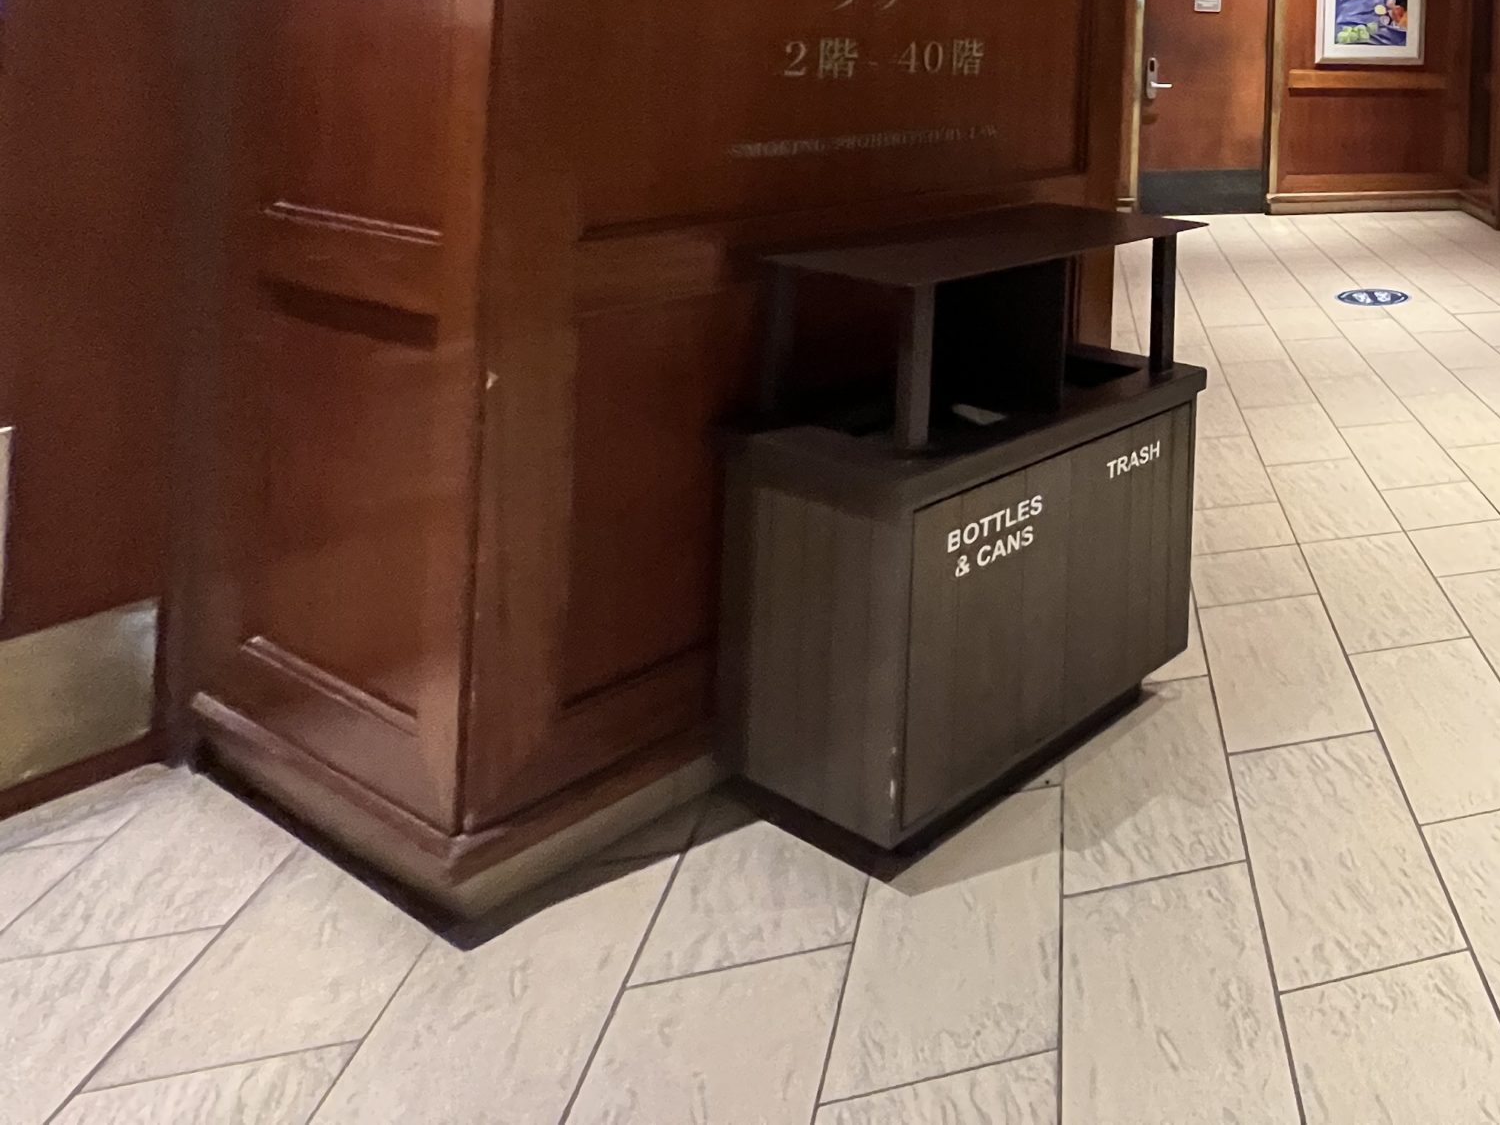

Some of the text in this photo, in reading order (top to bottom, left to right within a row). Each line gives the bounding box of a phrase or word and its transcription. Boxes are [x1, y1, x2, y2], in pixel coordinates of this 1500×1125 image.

[1106, 441, 1161, 479] TRASH
[947, 495, 1043, 553] BOTTLES
[954, 525, 1034, 577] & CANS
